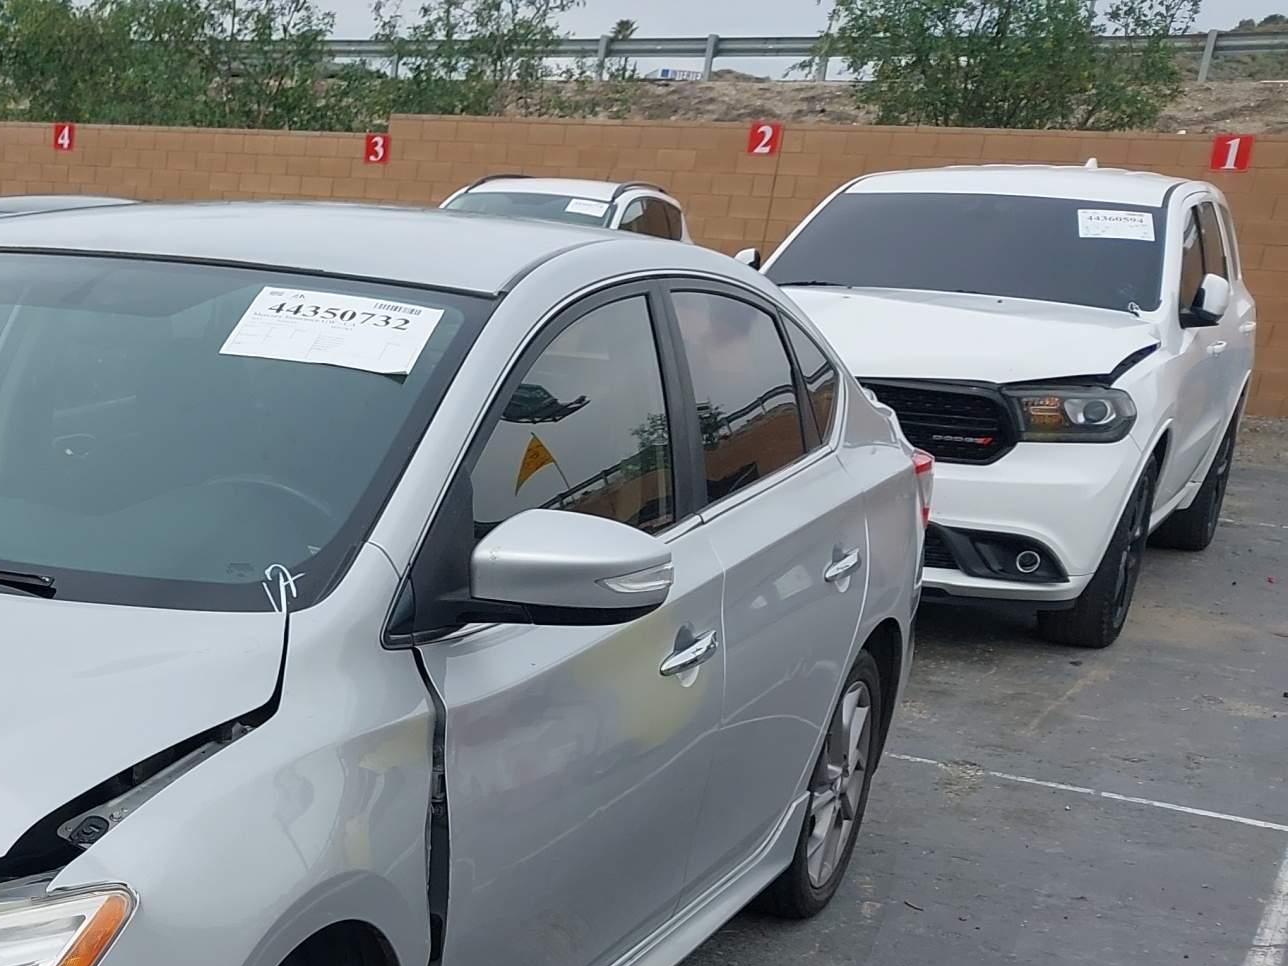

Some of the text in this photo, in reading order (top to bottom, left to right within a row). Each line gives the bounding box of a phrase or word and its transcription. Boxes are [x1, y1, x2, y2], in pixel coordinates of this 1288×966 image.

[57, 125, 70, 149] 4
[369, 136, 384, 161] 3
[753, 125, 773, 153] 2
[1220, 138, 1241, 169] 1
[268, 302, 410, 331] 44350732
